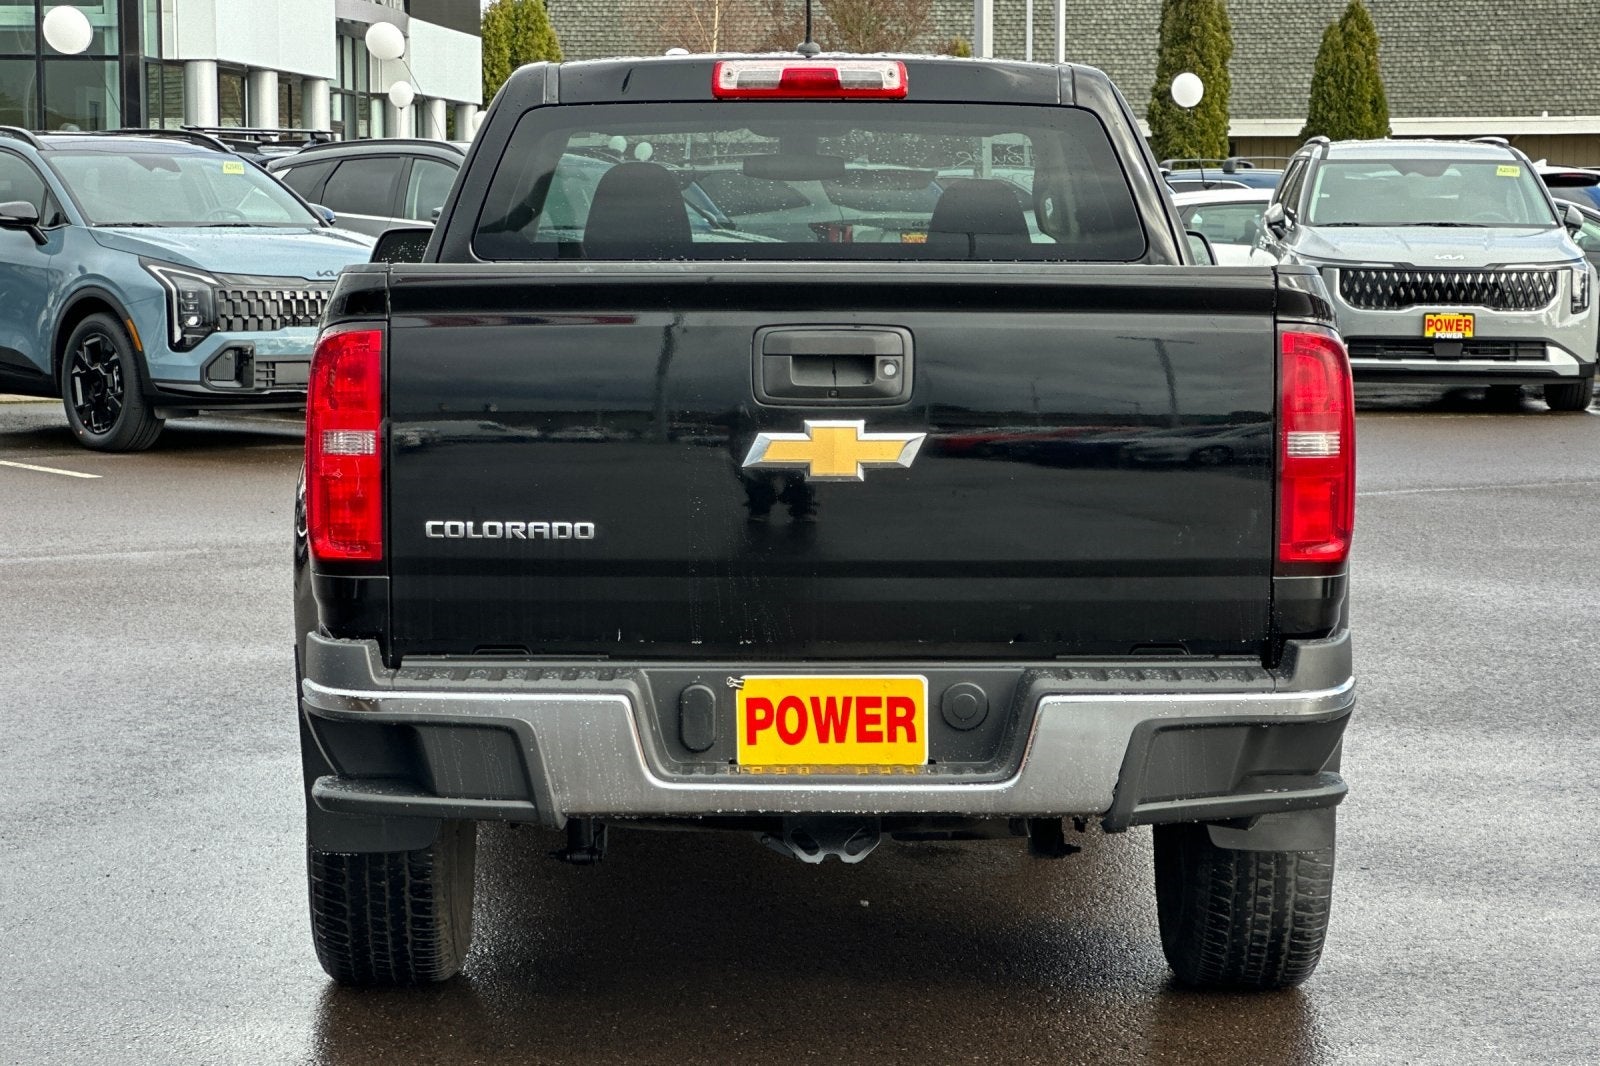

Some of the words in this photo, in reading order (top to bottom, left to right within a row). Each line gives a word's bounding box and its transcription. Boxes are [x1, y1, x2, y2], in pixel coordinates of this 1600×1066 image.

[1426, 318, 1472, 332] POWER
[425, 520, 595, 540] COLORADO
[745, 695, 917, 746] POWER
